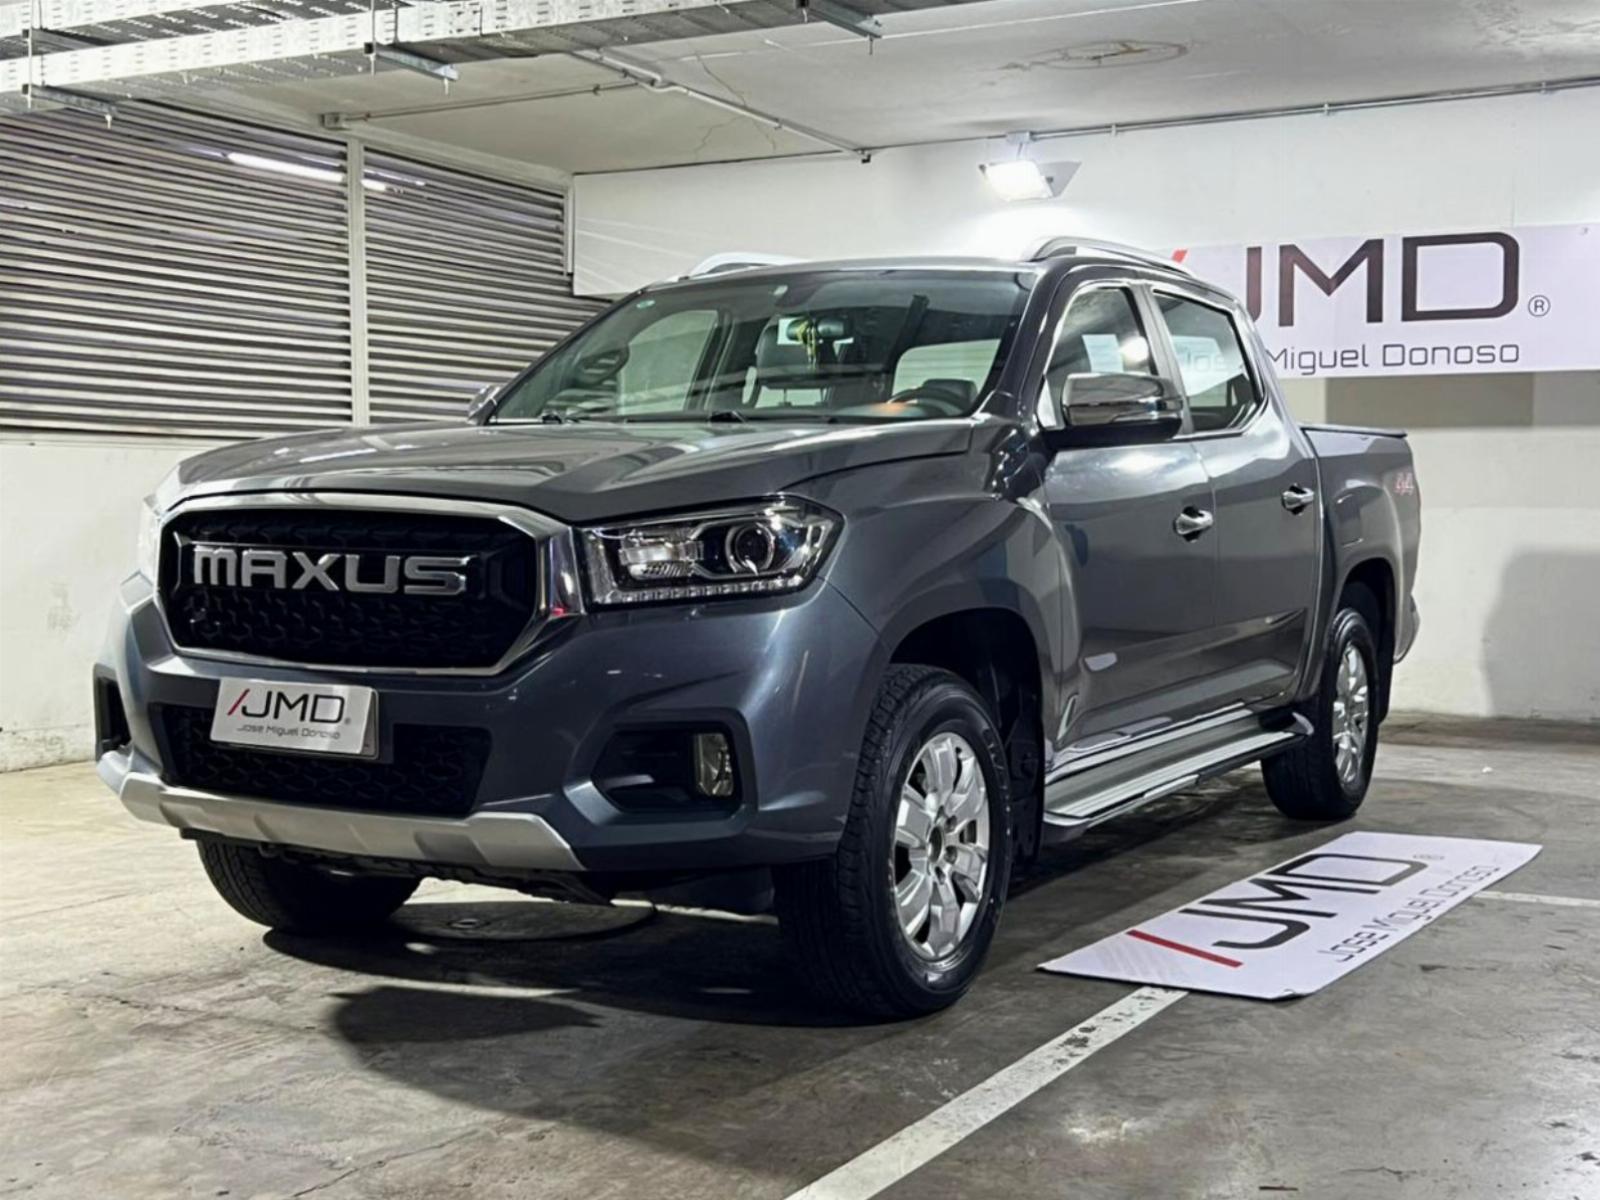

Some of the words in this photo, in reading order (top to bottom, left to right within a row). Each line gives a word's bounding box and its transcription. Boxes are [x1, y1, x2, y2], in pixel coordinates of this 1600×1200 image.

[1265, 344, 1369, 376] Miguel
[1382, 343, 1520, 367] Donoso
[193, 545, 471, 596] MAXUS
